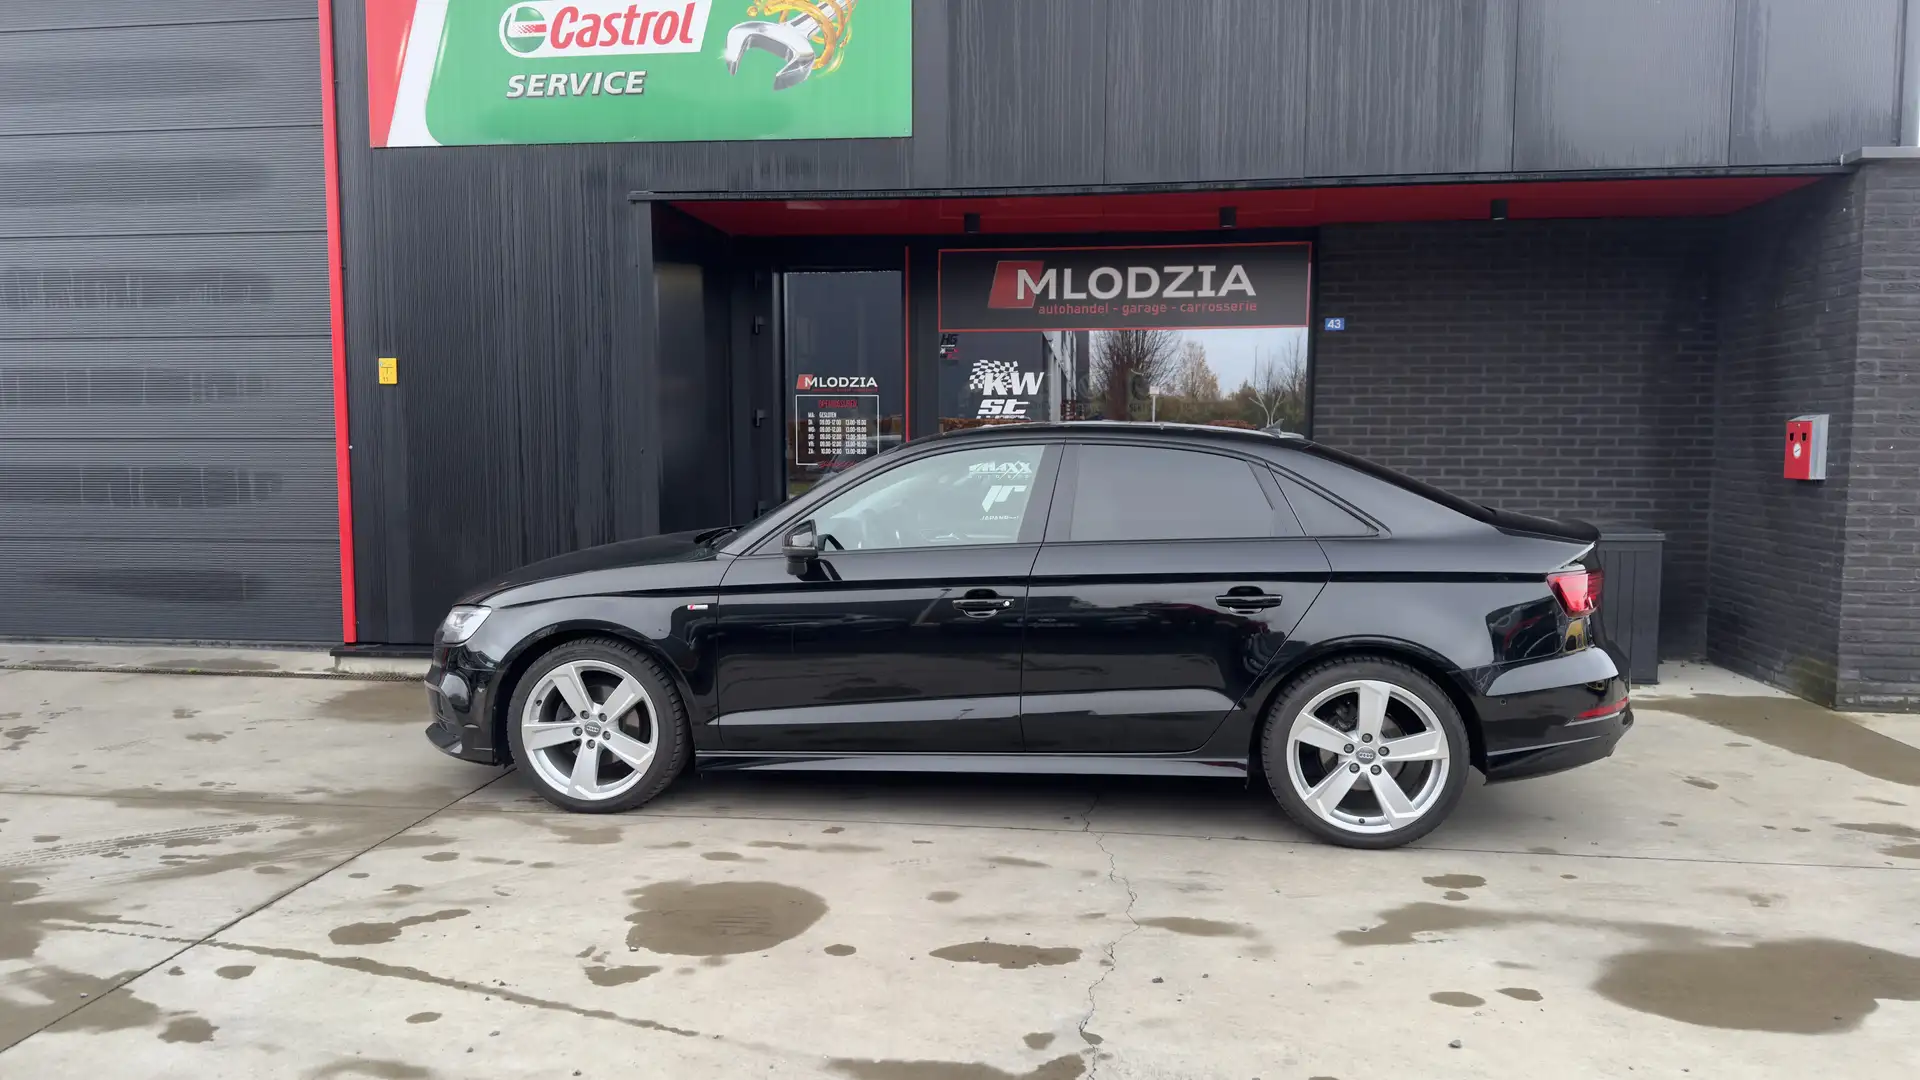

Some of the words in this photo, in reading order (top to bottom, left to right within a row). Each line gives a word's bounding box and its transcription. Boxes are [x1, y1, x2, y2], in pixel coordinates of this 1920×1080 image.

[550, 2, 696, 49] Castrol
[506, 70, 647, 98] SERVICE
[1017, 265, 1256, 300] MLODZIA
[1038, 303, 1109, 315] autohandel
[1122, 303, 1167, 316] garage
[1180, 301, 1257, 313] carrosserie
[1327, 319, 1341, 329] 43
[804, 377, 878, 387] MLODZIA
[982, 371, 1045, 396] KW
